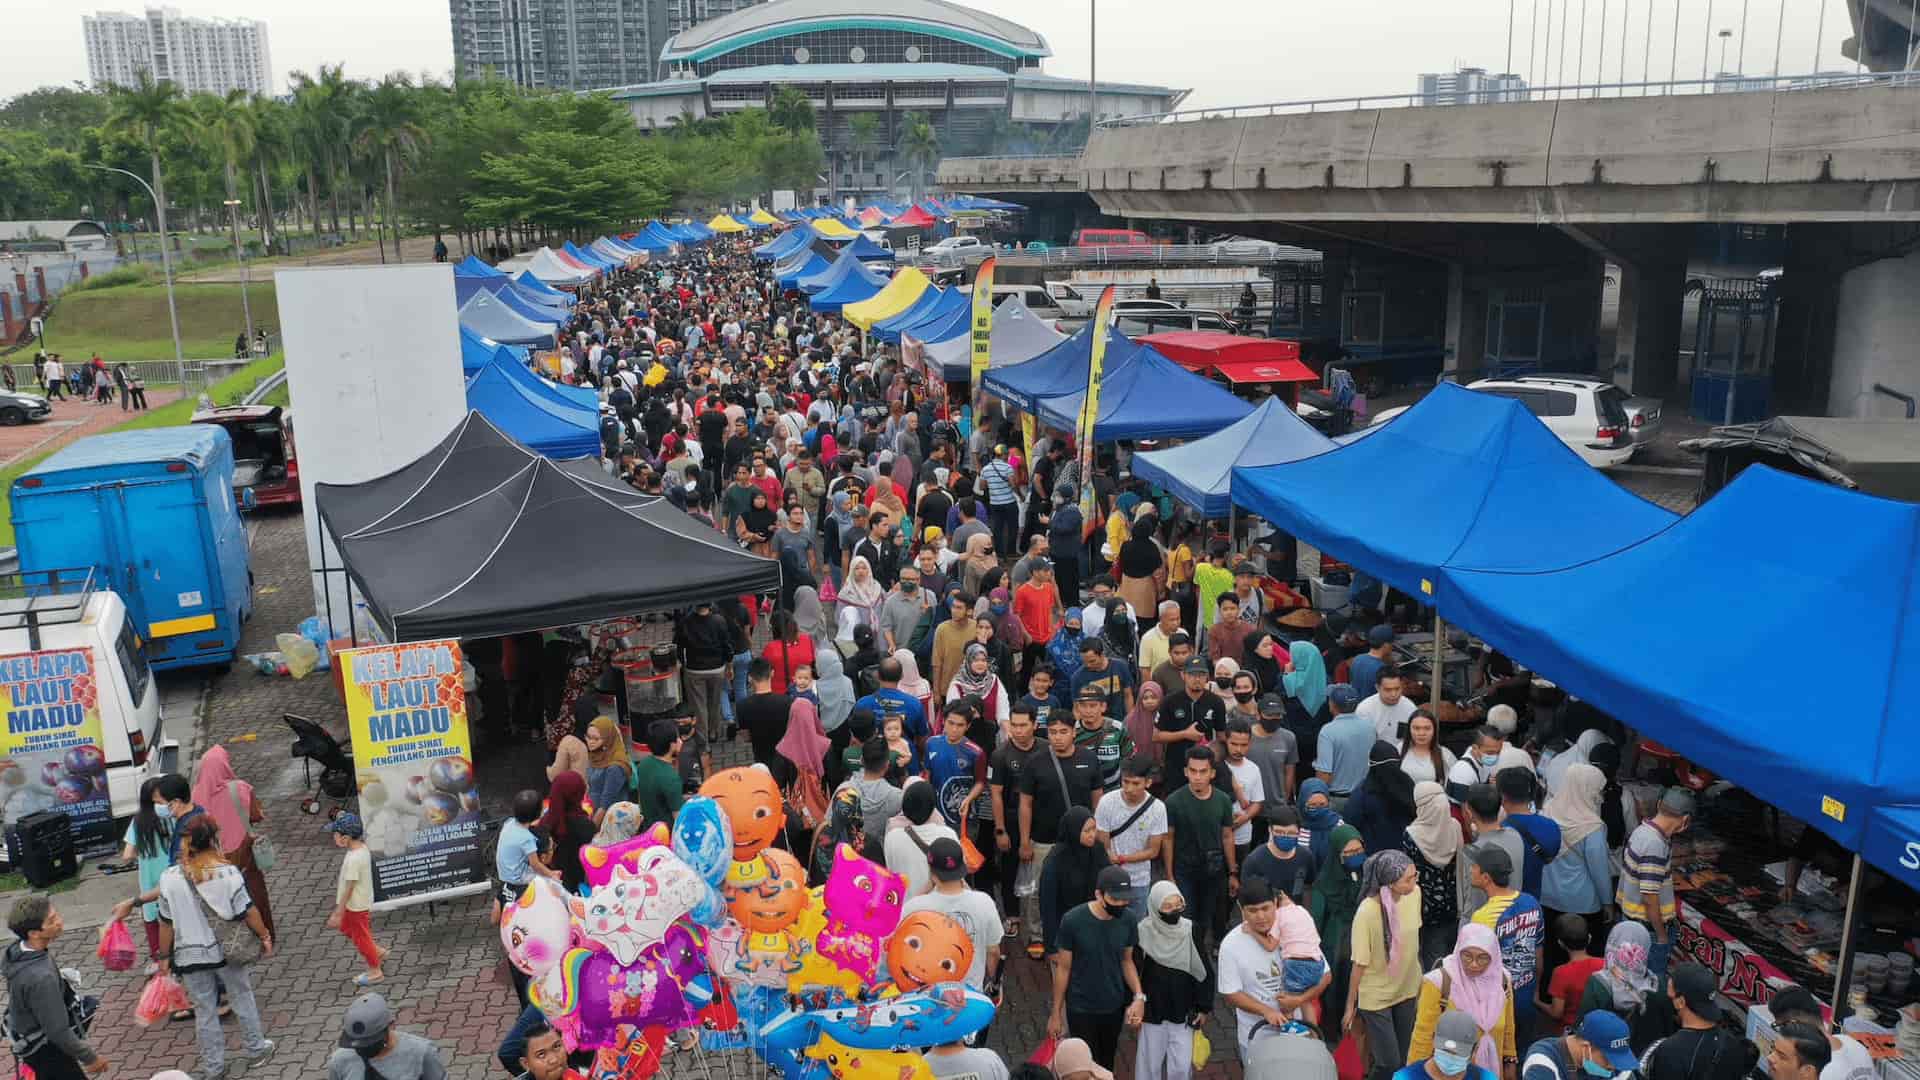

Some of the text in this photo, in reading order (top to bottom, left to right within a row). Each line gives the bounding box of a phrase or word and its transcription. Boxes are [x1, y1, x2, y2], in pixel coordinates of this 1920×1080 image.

[0, 652, 88, 683] KELAPA
[352, 645, 455, 685] KELAPA
[11, 678, 74, 707] LAUT
[371, 678, 439, 712] LAUT
[7, 703, 84, 733] MADU
[368, 706, 451, 743] MADU
[371, 746, 462, 766] PENGHILANG DAHAGA
[387, 738, 443, 754] TUBUH SIHAT
